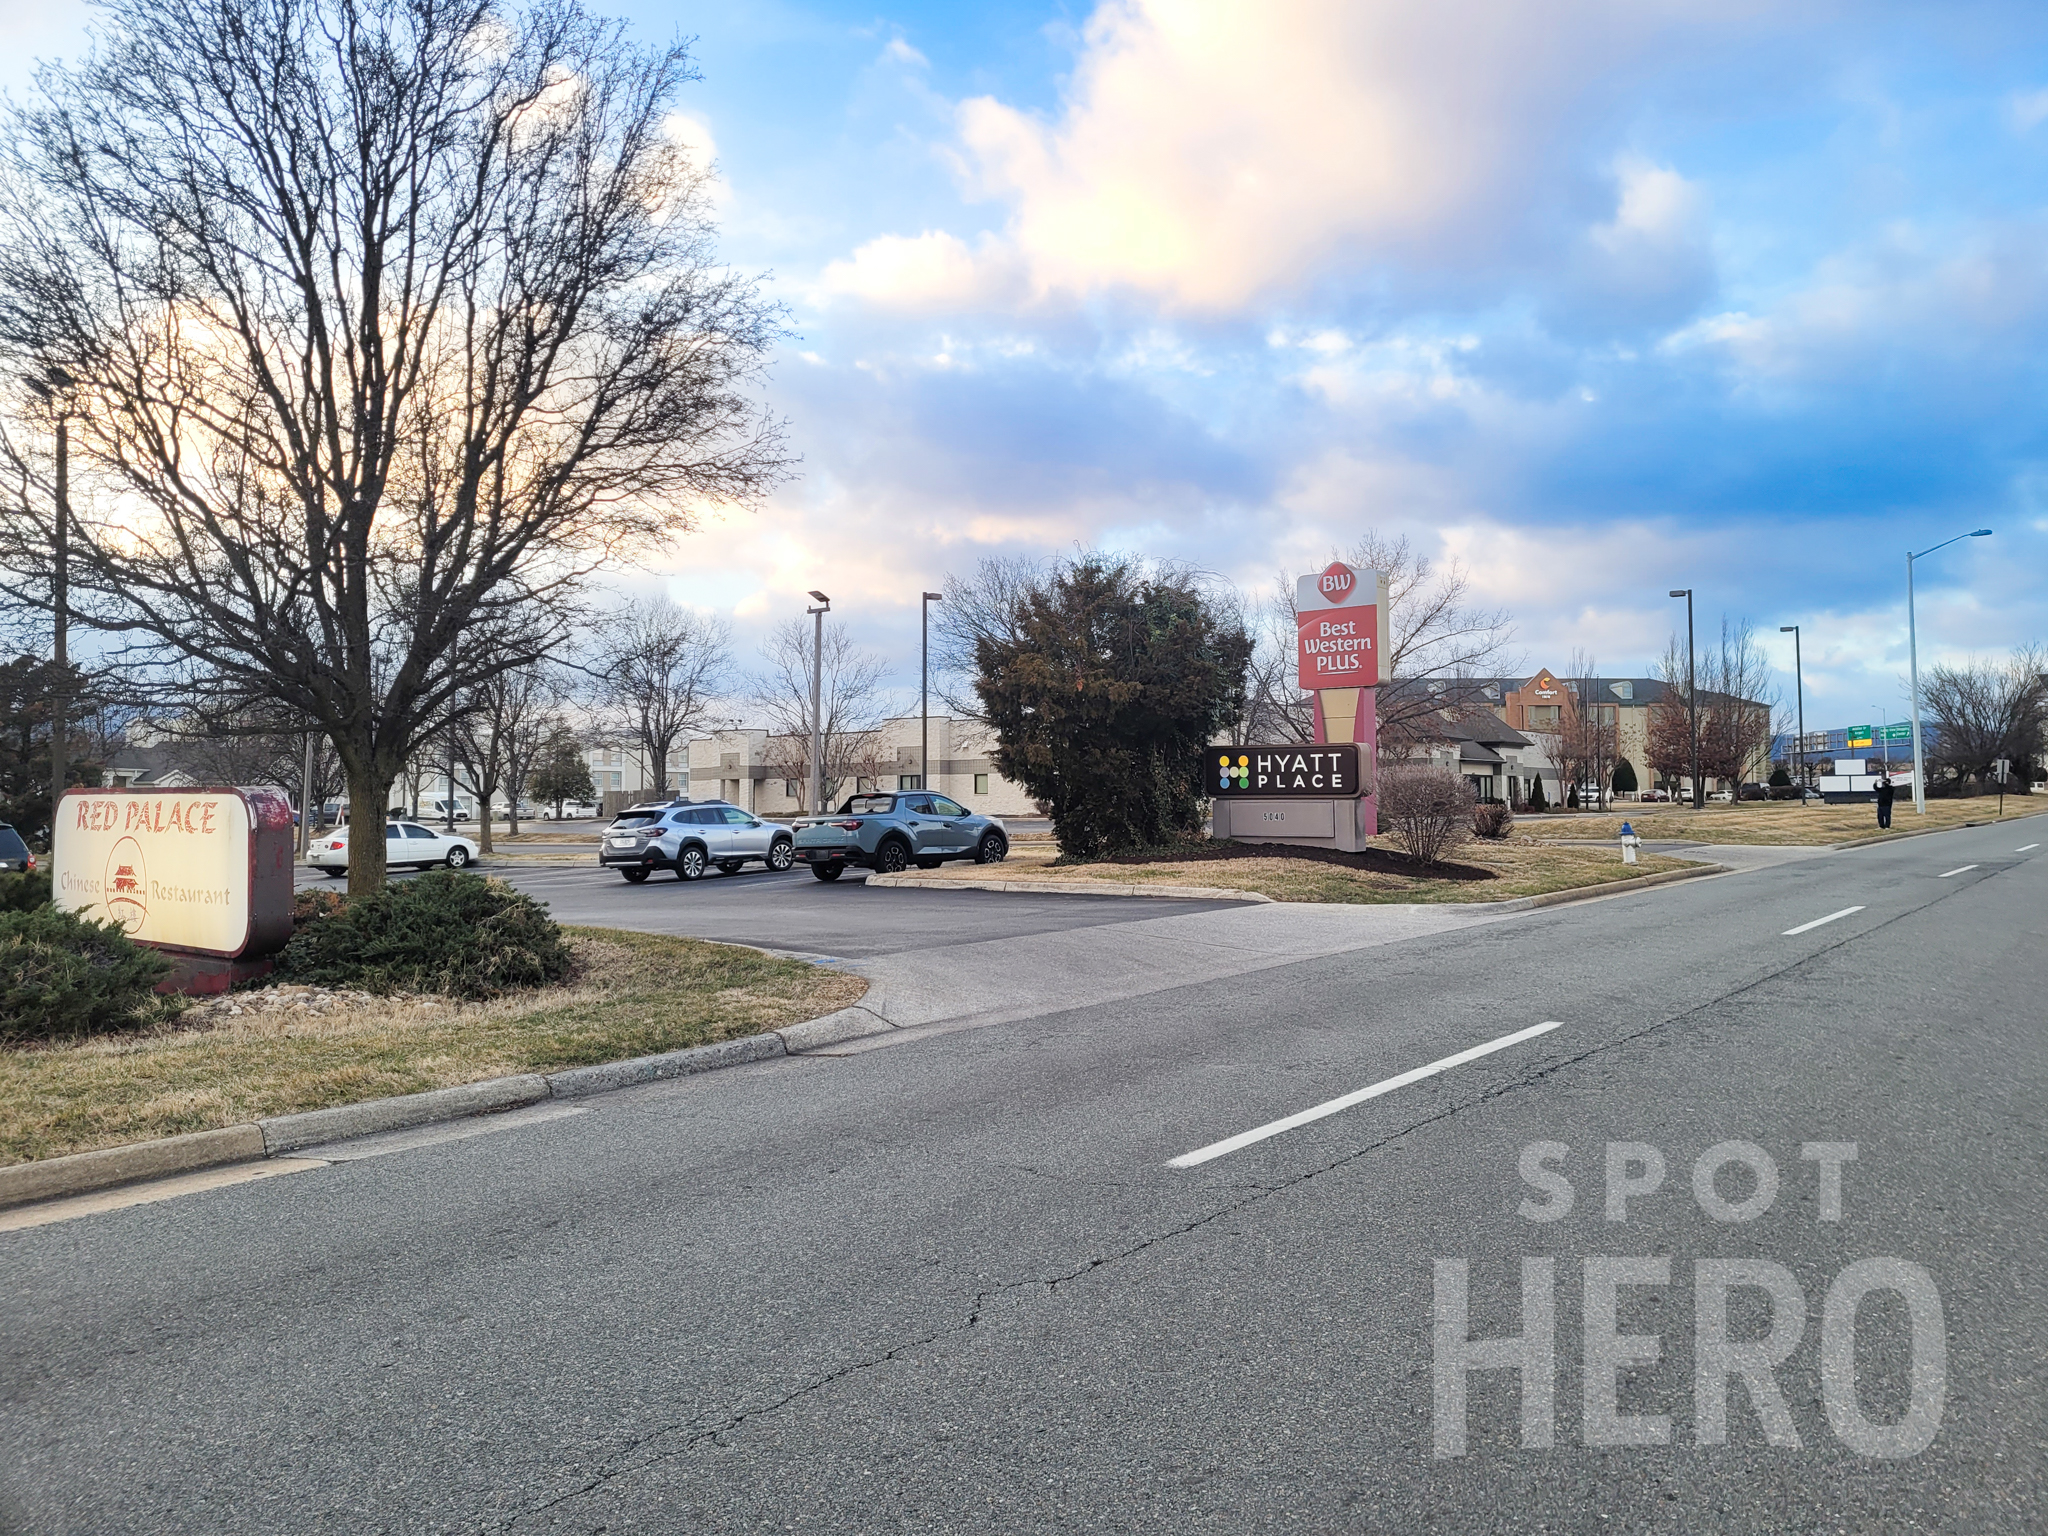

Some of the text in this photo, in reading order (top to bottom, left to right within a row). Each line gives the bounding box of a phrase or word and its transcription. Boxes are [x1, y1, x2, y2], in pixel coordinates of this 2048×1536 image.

[1322, 574, 1351, 592] BW
[1320, 621, 1356, 637] Best
[1304, 636, 1372, 654] Western
[1316, 653, 1360, 672] PLUS
[1257, 752, 1342, 773] HYATT
[1258, 773, 1343, 789] PLACE
[76, 800, 219, 835] RED PALACE
[1263, 812, 1286, 822] 5040
[61, 870, 231, 906] Chinese Restaurant
